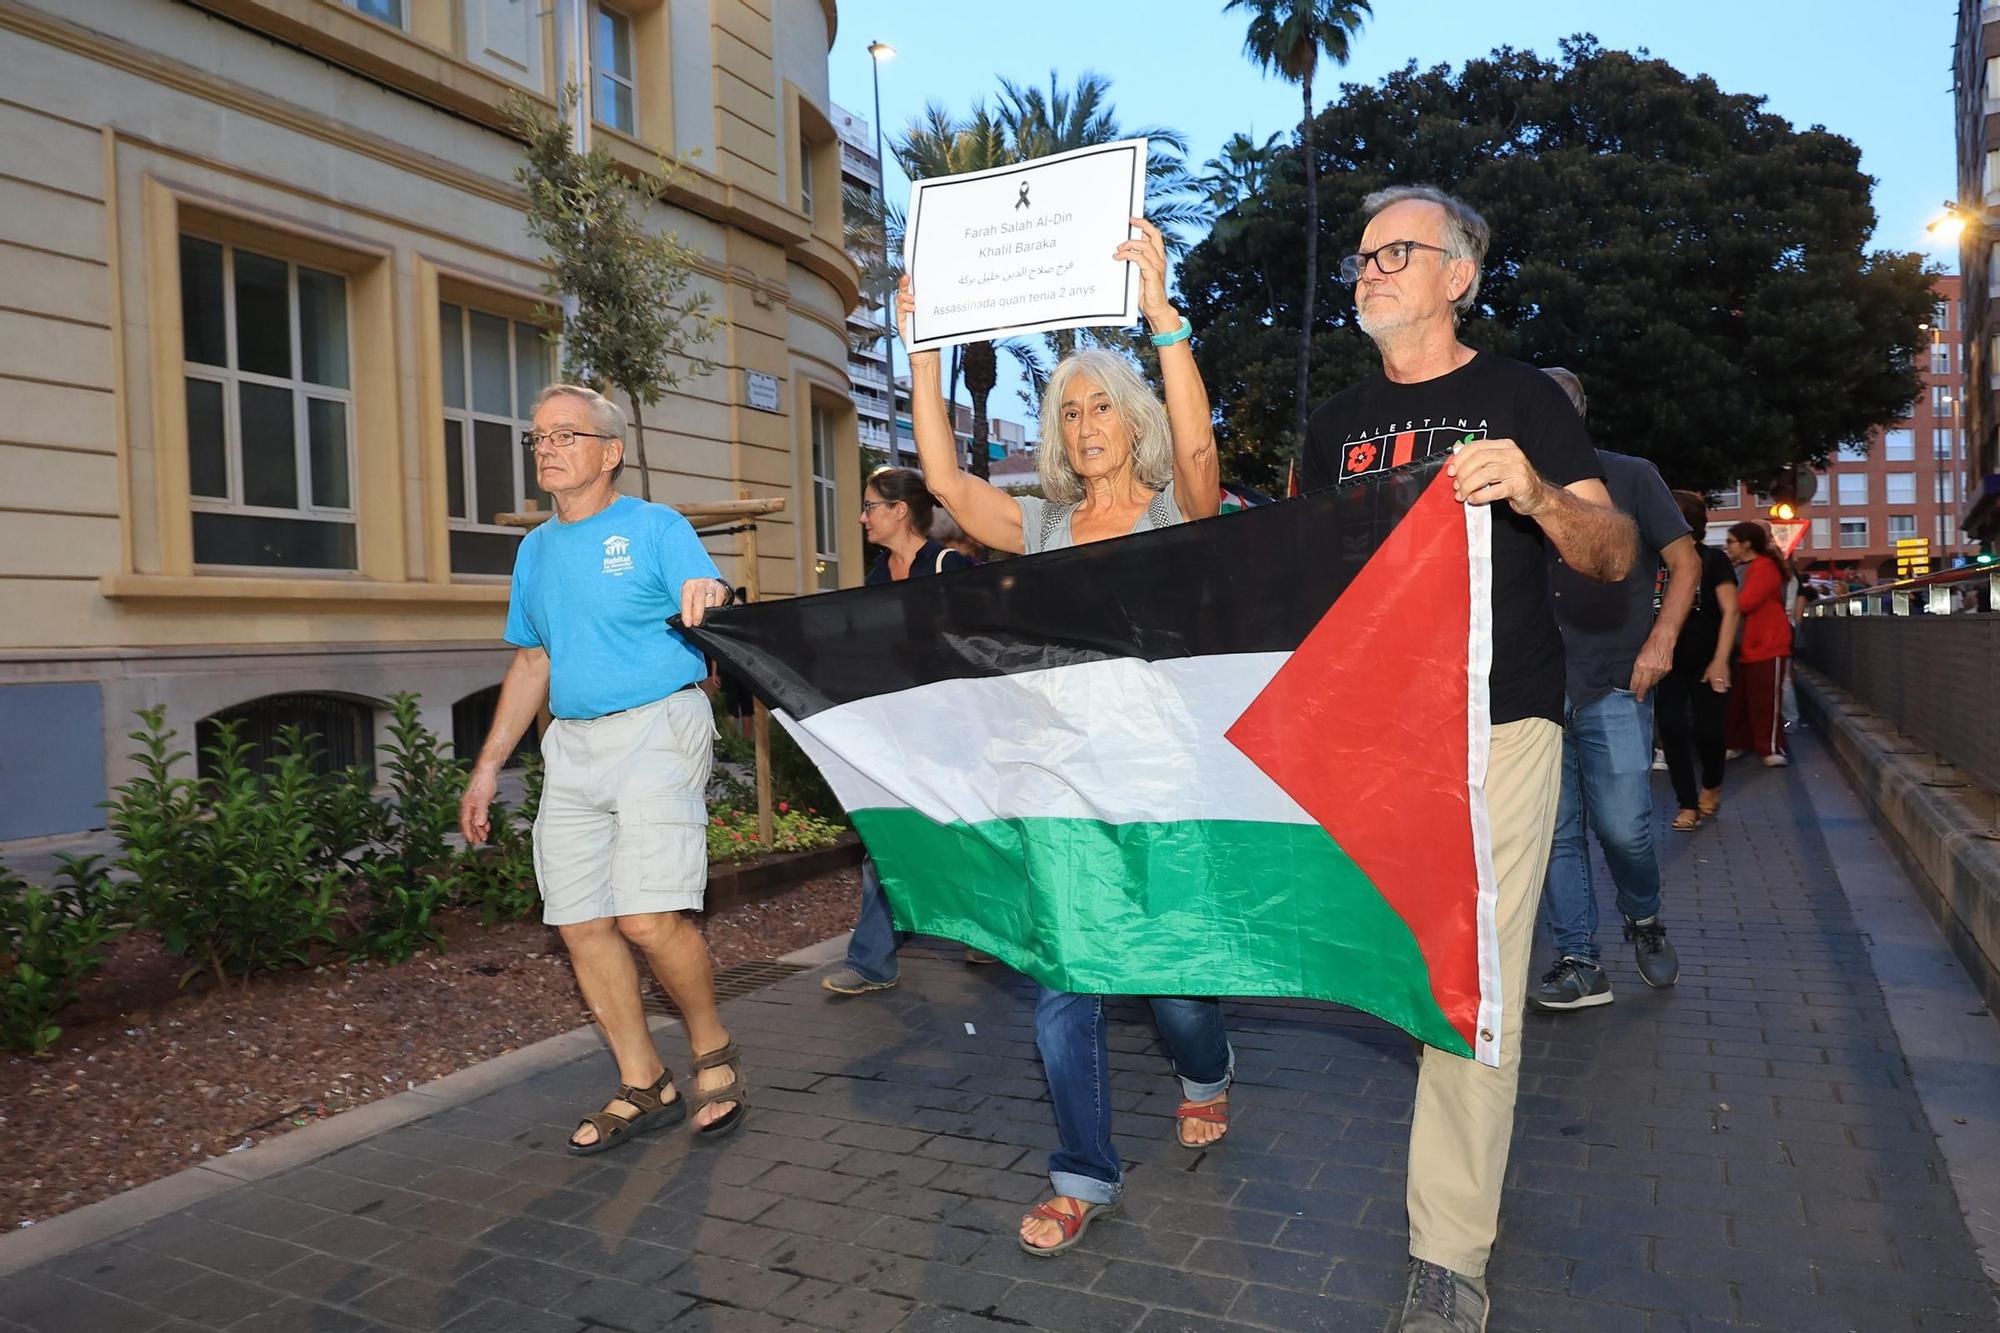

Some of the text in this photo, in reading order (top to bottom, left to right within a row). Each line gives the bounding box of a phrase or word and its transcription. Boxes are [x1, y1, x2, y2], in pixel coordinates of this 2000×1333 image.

[964, 212, 1073, 239] Farah Salah Al-Din
[1015, 238, 1057, 254] Baraka
[933, 297, 996, 317] Assassinada
[999, 294, 1026, 308] quan
[1058, 287, 1066, 298] 2
[1069, 284, 1096, 298] anys
